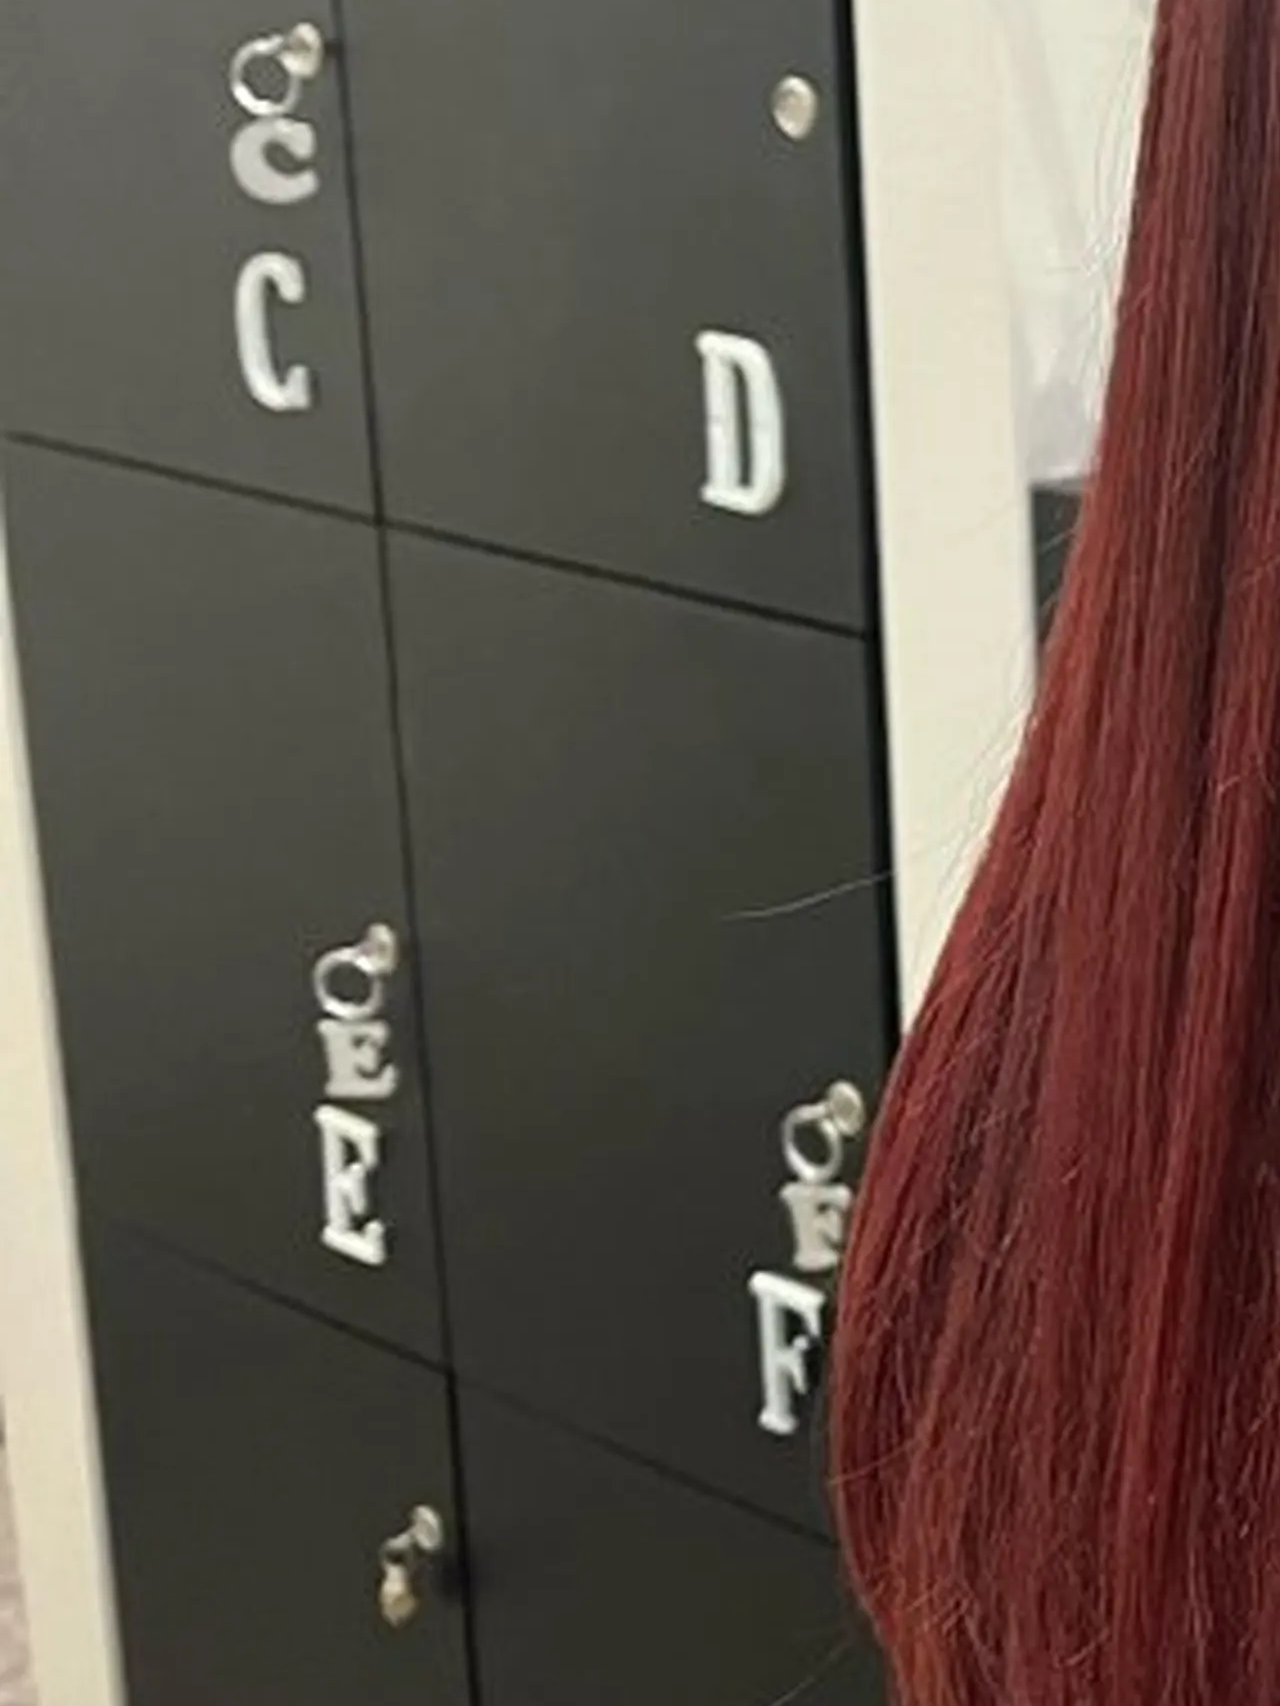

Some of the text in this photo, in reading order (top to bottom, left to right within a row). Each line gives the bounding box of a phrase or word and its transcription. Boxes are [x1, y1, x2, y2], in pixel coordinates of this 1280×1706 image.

[233, 250, 311, 412] C
[694, 329, 786, 516] D
[313, 1105, 387, 1266] E
[748, 1270, 827, 1437] F
